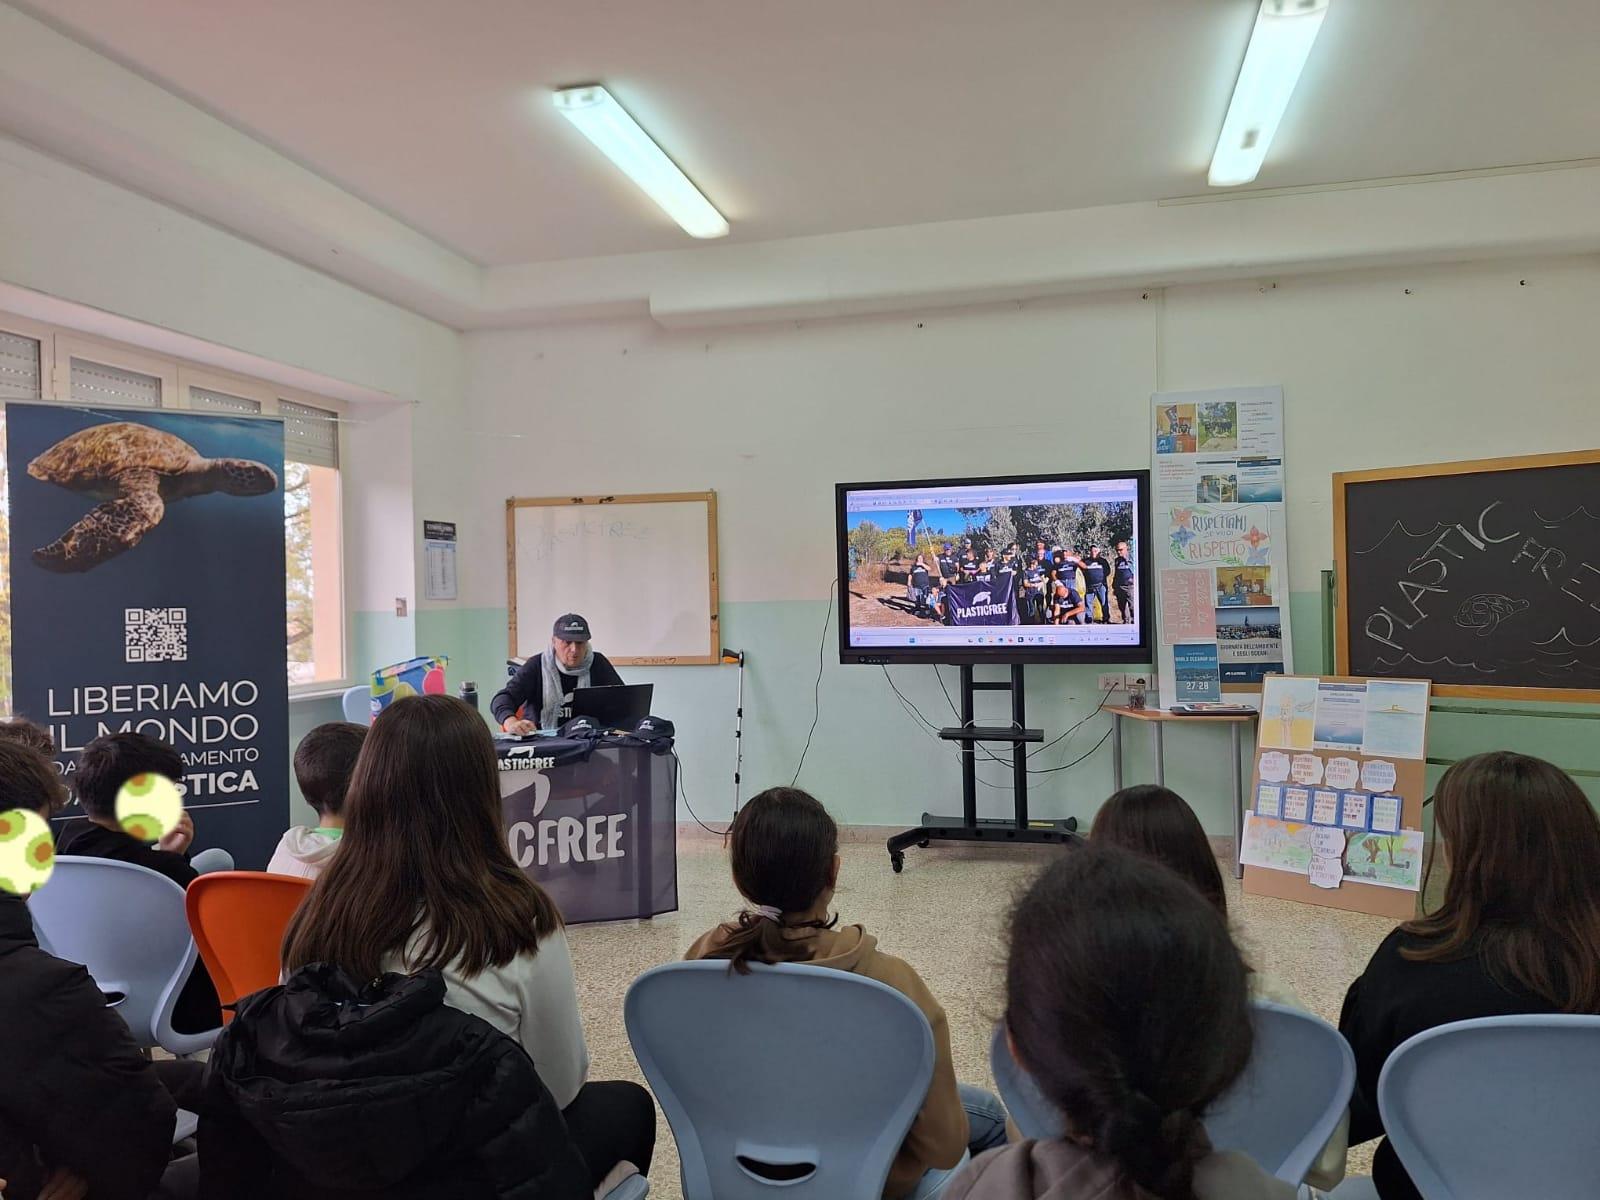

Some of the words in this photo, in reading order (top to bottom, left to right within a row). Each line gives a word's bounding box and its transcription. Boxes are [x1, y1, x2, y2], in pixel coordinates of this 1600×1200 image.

[1189, 540, 1246, 559] RISPETTO
[1512, 537, 1600, 613] FRE
[957, 603, 1008, 618] PLASTICFREE
[49, 680, 259, 716] LIBERIAMO
[50, 724, 85, 752] IL
[181, 748, 259, 767] AMENTO
[175, 770, 259, 797] STICA
[508, 813, 628, 868] CFREE
